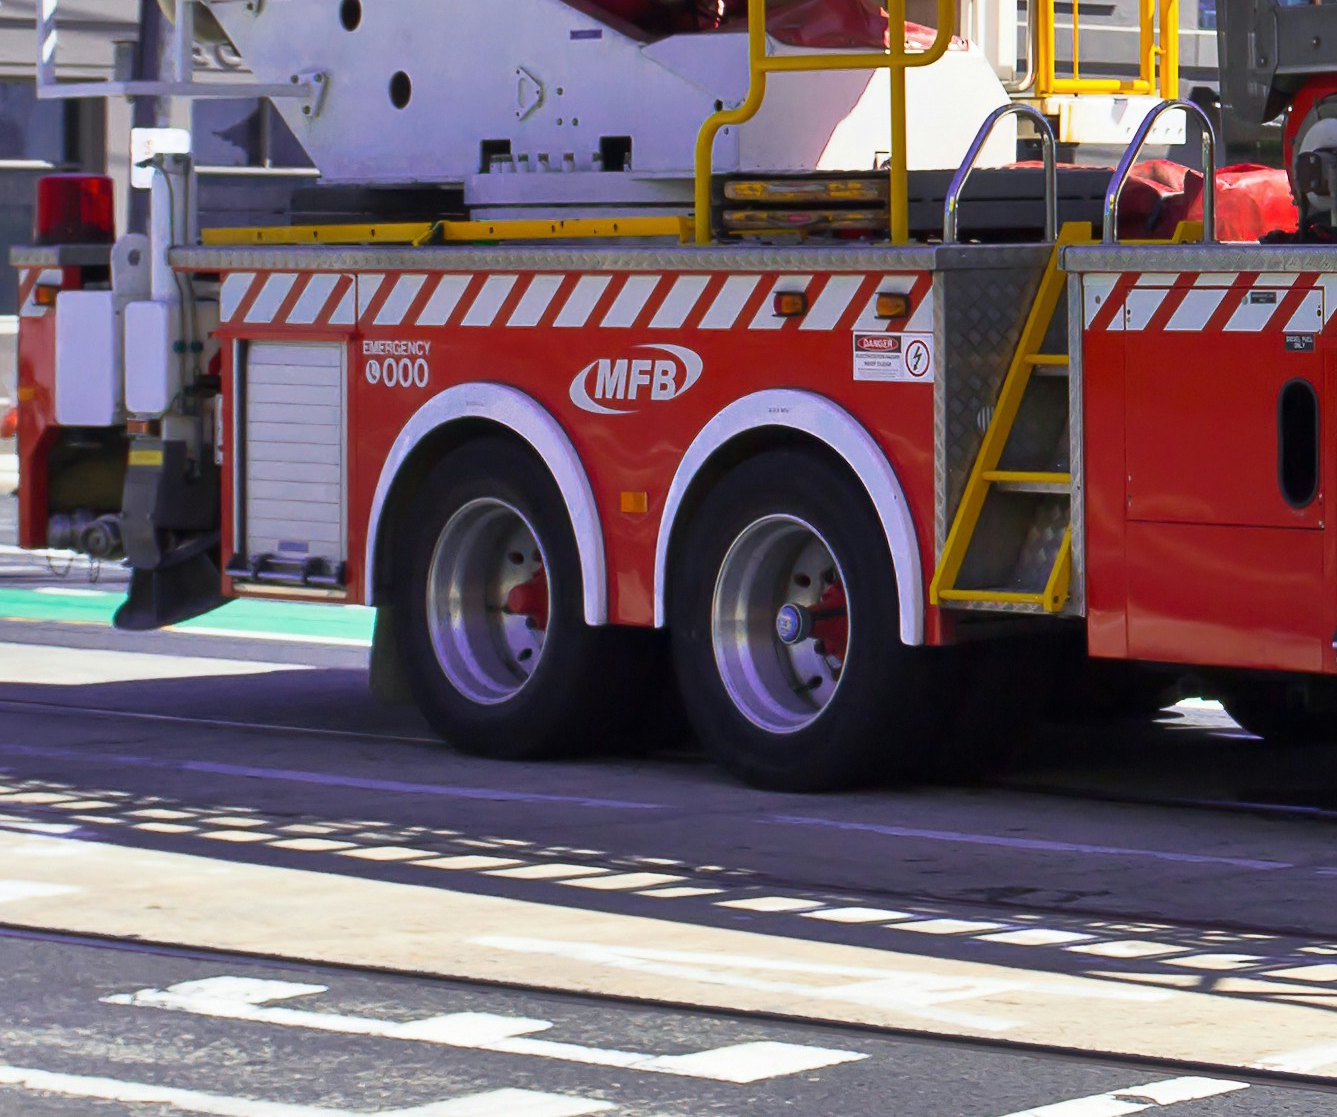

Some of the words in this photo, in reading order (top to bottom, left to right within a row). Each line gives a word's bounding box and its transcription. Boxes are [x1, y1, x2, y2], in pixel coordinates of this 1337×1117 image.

[363, 340, 432, 356] EMERGENCY
[382, 357, 429, 388] 000
[595, 358, 677, 401] MFB
